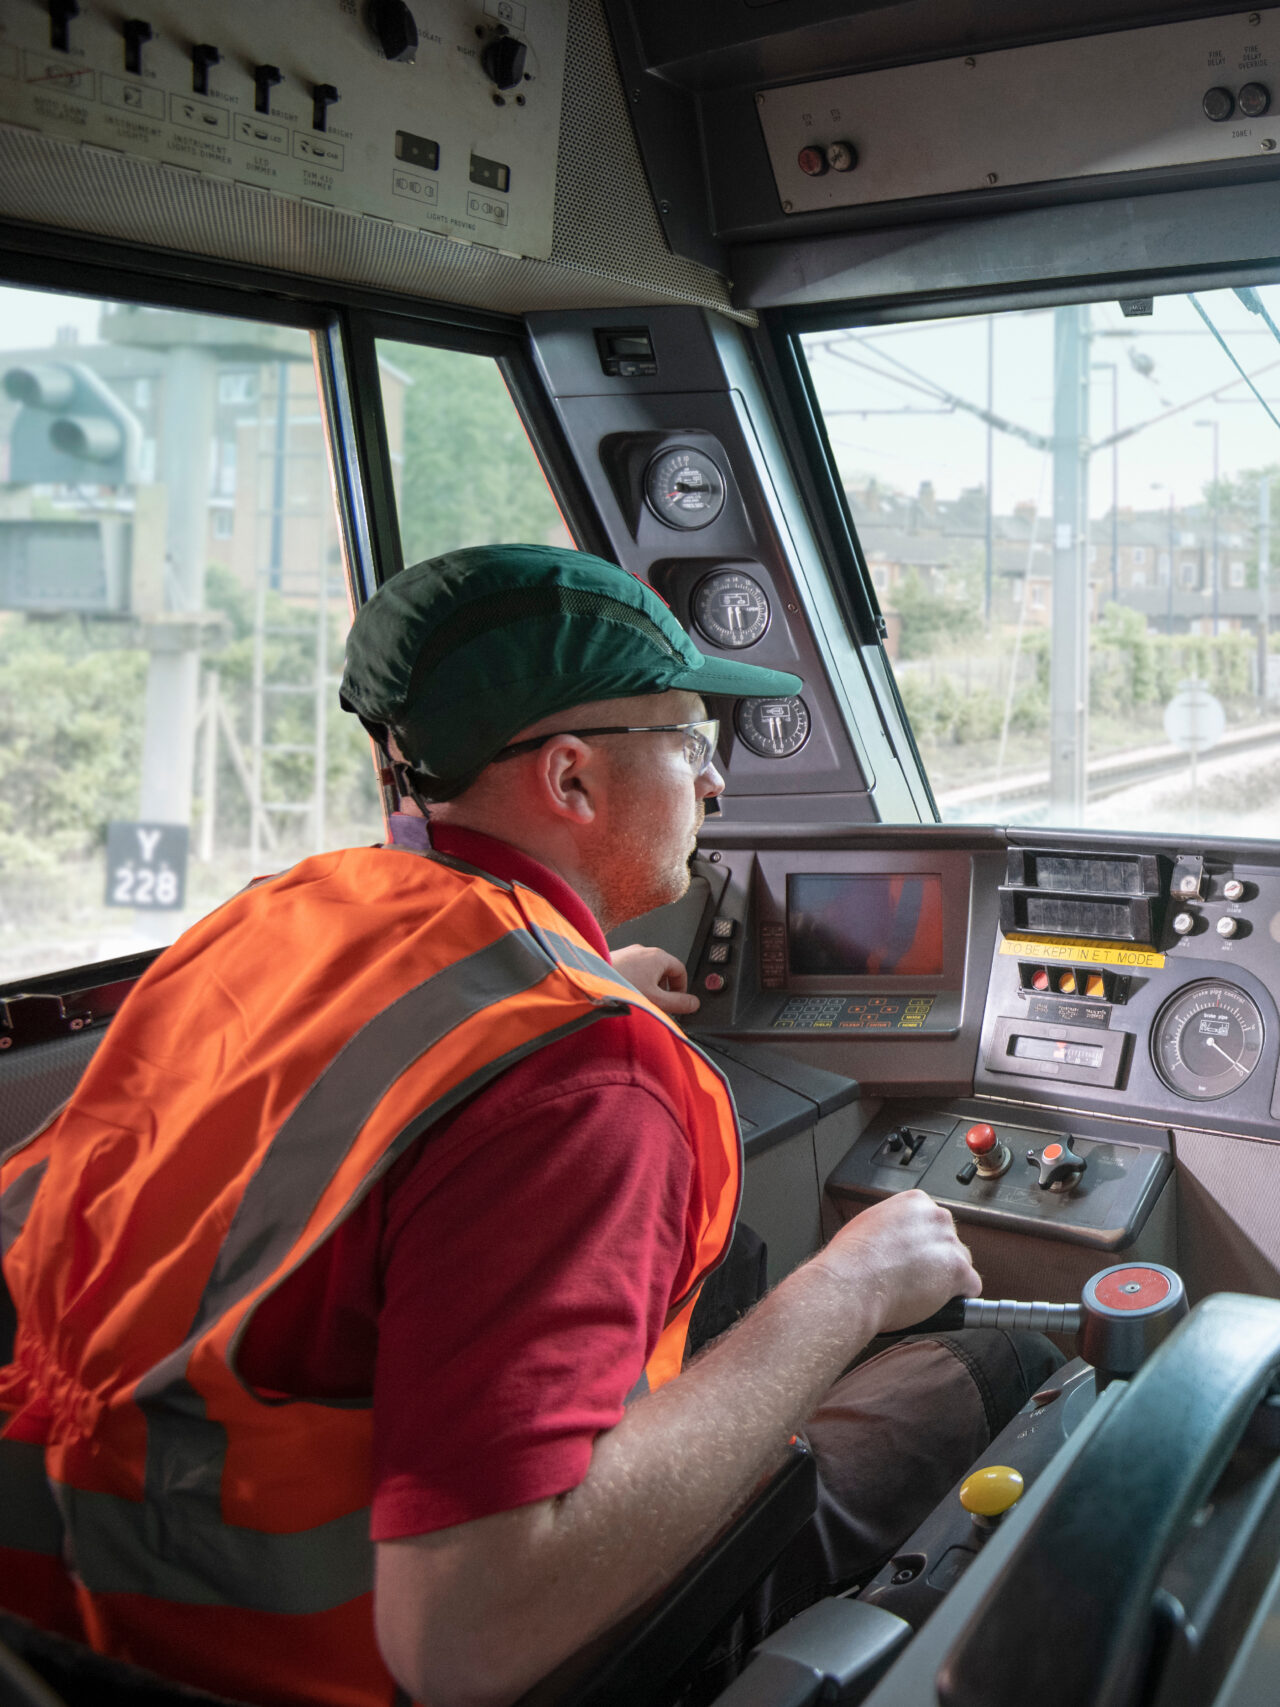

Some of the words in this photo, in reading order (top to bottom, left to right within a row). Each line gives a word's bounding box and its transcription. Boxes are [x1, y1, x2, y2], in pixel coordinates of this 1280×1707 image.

[1208, 50, 1223, 58] FIRE
[1244, 46, 1259, 54] FIRE
[1207, 57, 1226, 67] DELAY
[1242, 53, 1263, 62] DELAY
[1238, 59, 1268, 70] OVERRIDE
[270, 108, 299, 122] BRIGHT
[327, 127, 353, 140] BRIGHT
[1232, 130, 1248, 138] ZONE
[173, 134, 227, 154] INSTRUMENT
[166, 142, 197, 156] LIGHTS
[200, 150, 233, 165] DIMMER
[254, 155, 270, 167] LED
[246, 162, 277, 177] DIMMER
[303, 178, 332, 191] DIMMER
[426, 211, 447, 224] LIGHTS
[450, 217, 477, 231] PROVING
[137, 829, 162, 862] Y
[114, 868, 178, 905] 228
[1006, 942, 1022, 954] TO
[1025, 944, 1041, 956] BE
[1044, 946, 1073, 958] KEPT
[1076, 949, 1089, 960] IN
[1118, 953, 1154, 966] MODE
